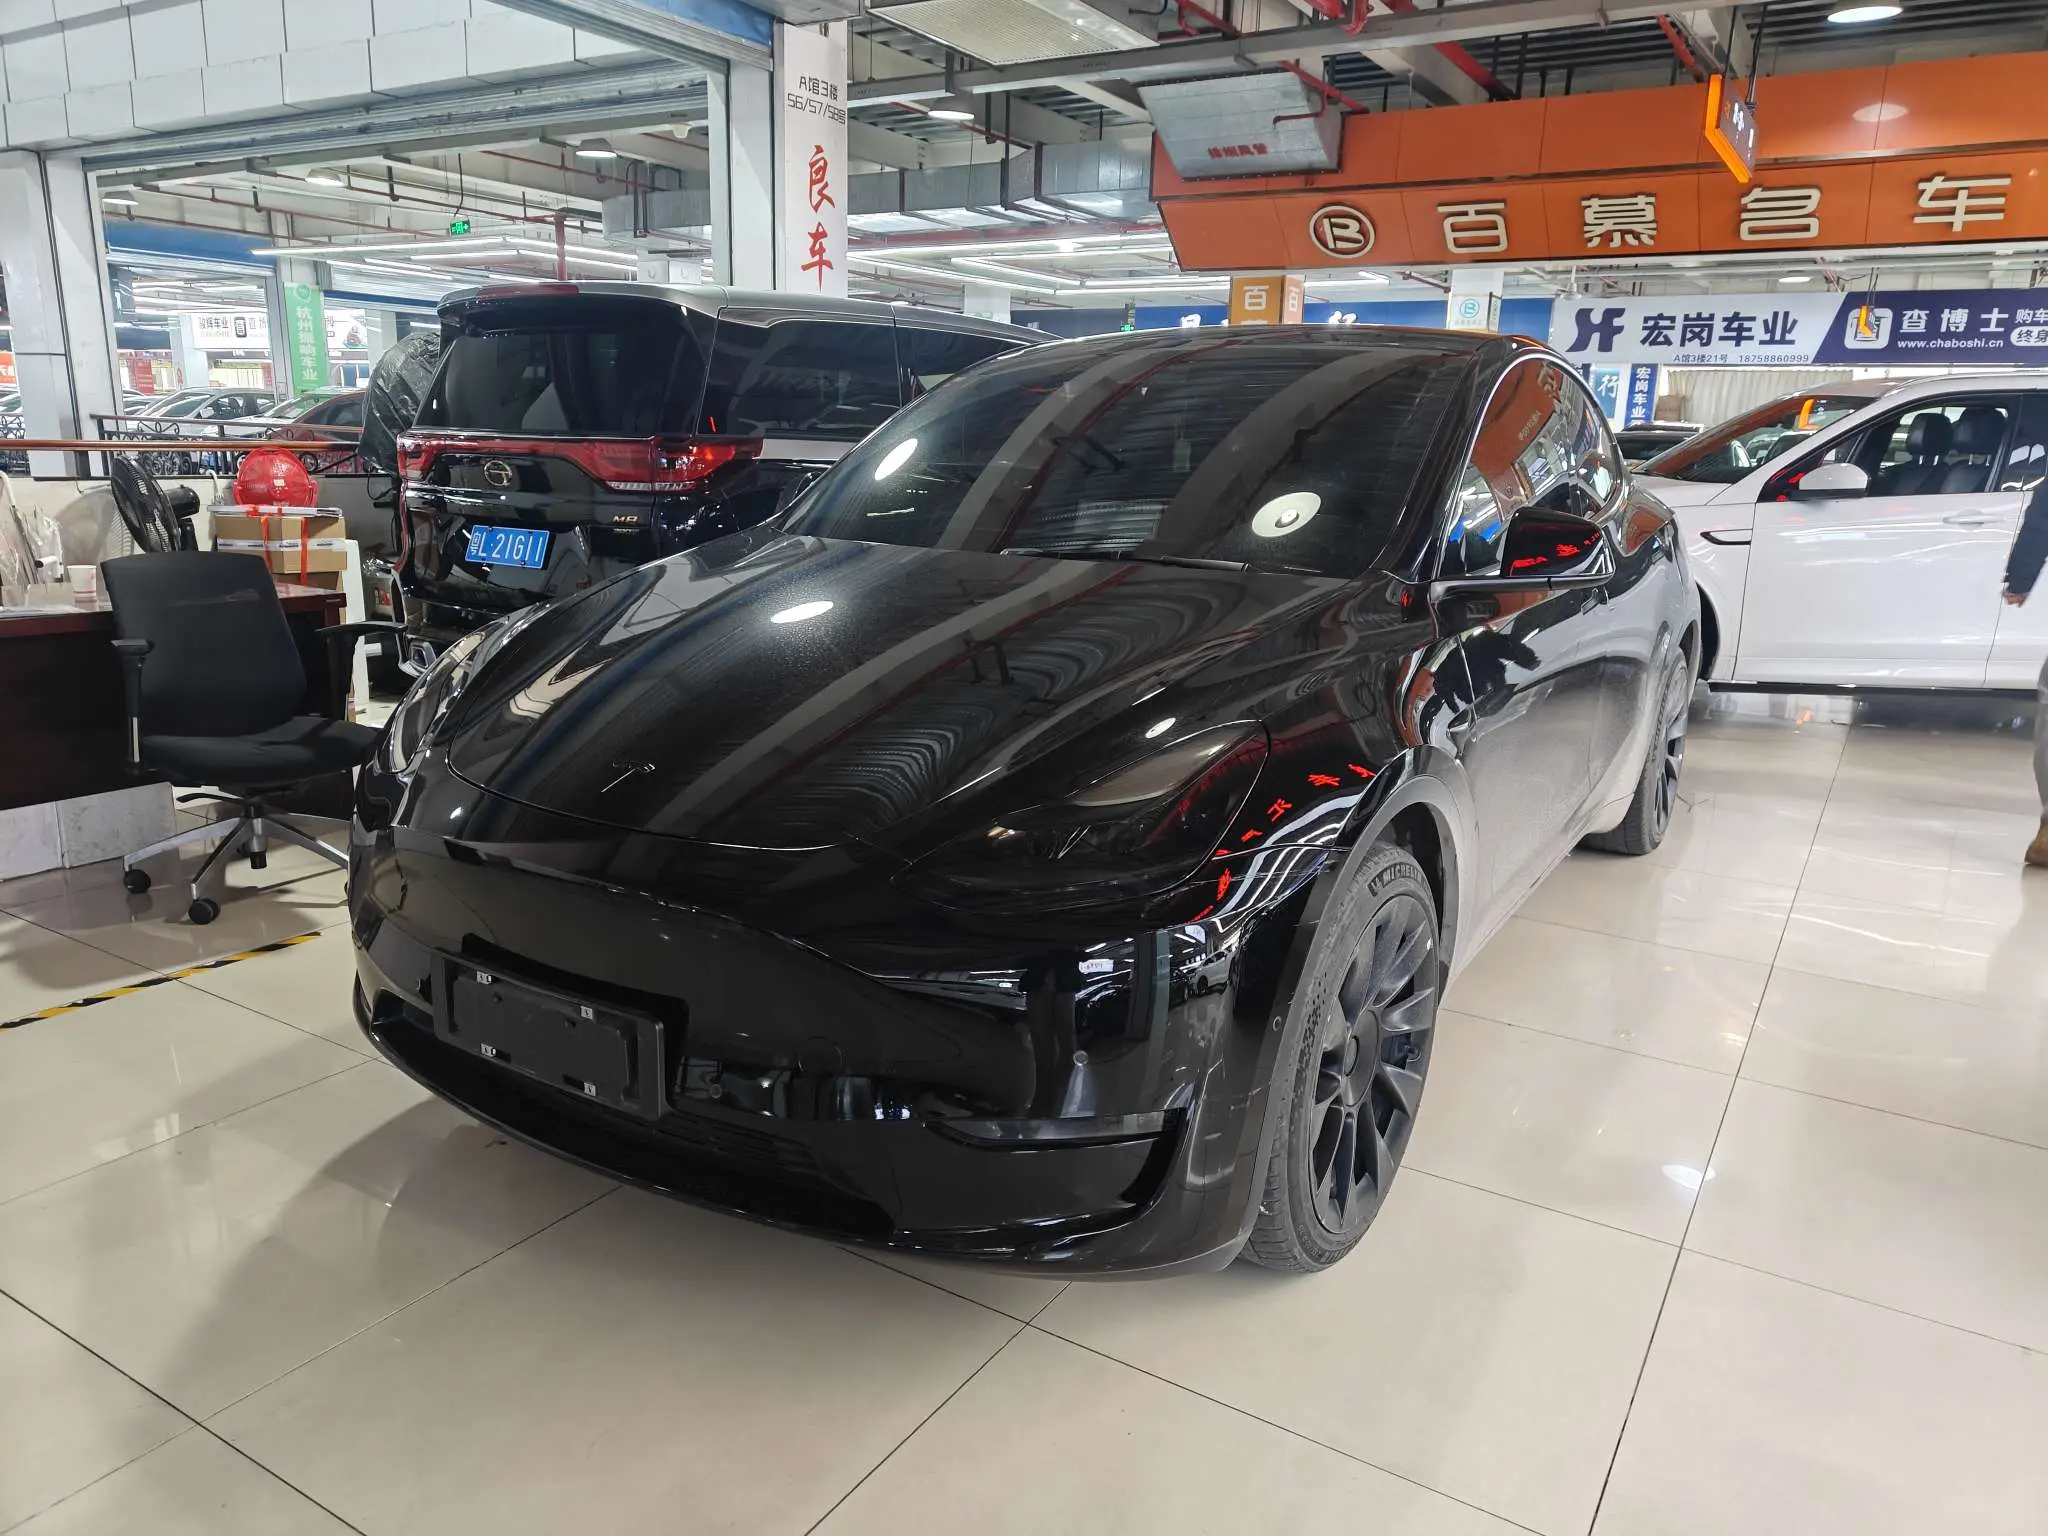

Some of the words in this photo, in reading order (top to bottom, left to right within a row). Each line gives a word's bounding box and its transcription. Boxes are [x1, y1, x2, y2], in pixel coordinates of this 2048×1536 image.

[798, 74, 838, 102] A馆3楼
[787, 92, 846, 125] 56/57/58号
[800, 144, 836, 293] 良车
[1436, 176, 2014, 256] 百慕名车
[1639, 310, 1799, 348] 宏岗车业
[1899, 307, 2009, 333] 查博士
[2014, 308, 2048, 324] 购车
[1897, 337, 2005, 350] www.chaboshi.cn
[1672, 353, 1729, 364] A馆3楼21号
[1738, 354, 1810, 364] 18758860999
